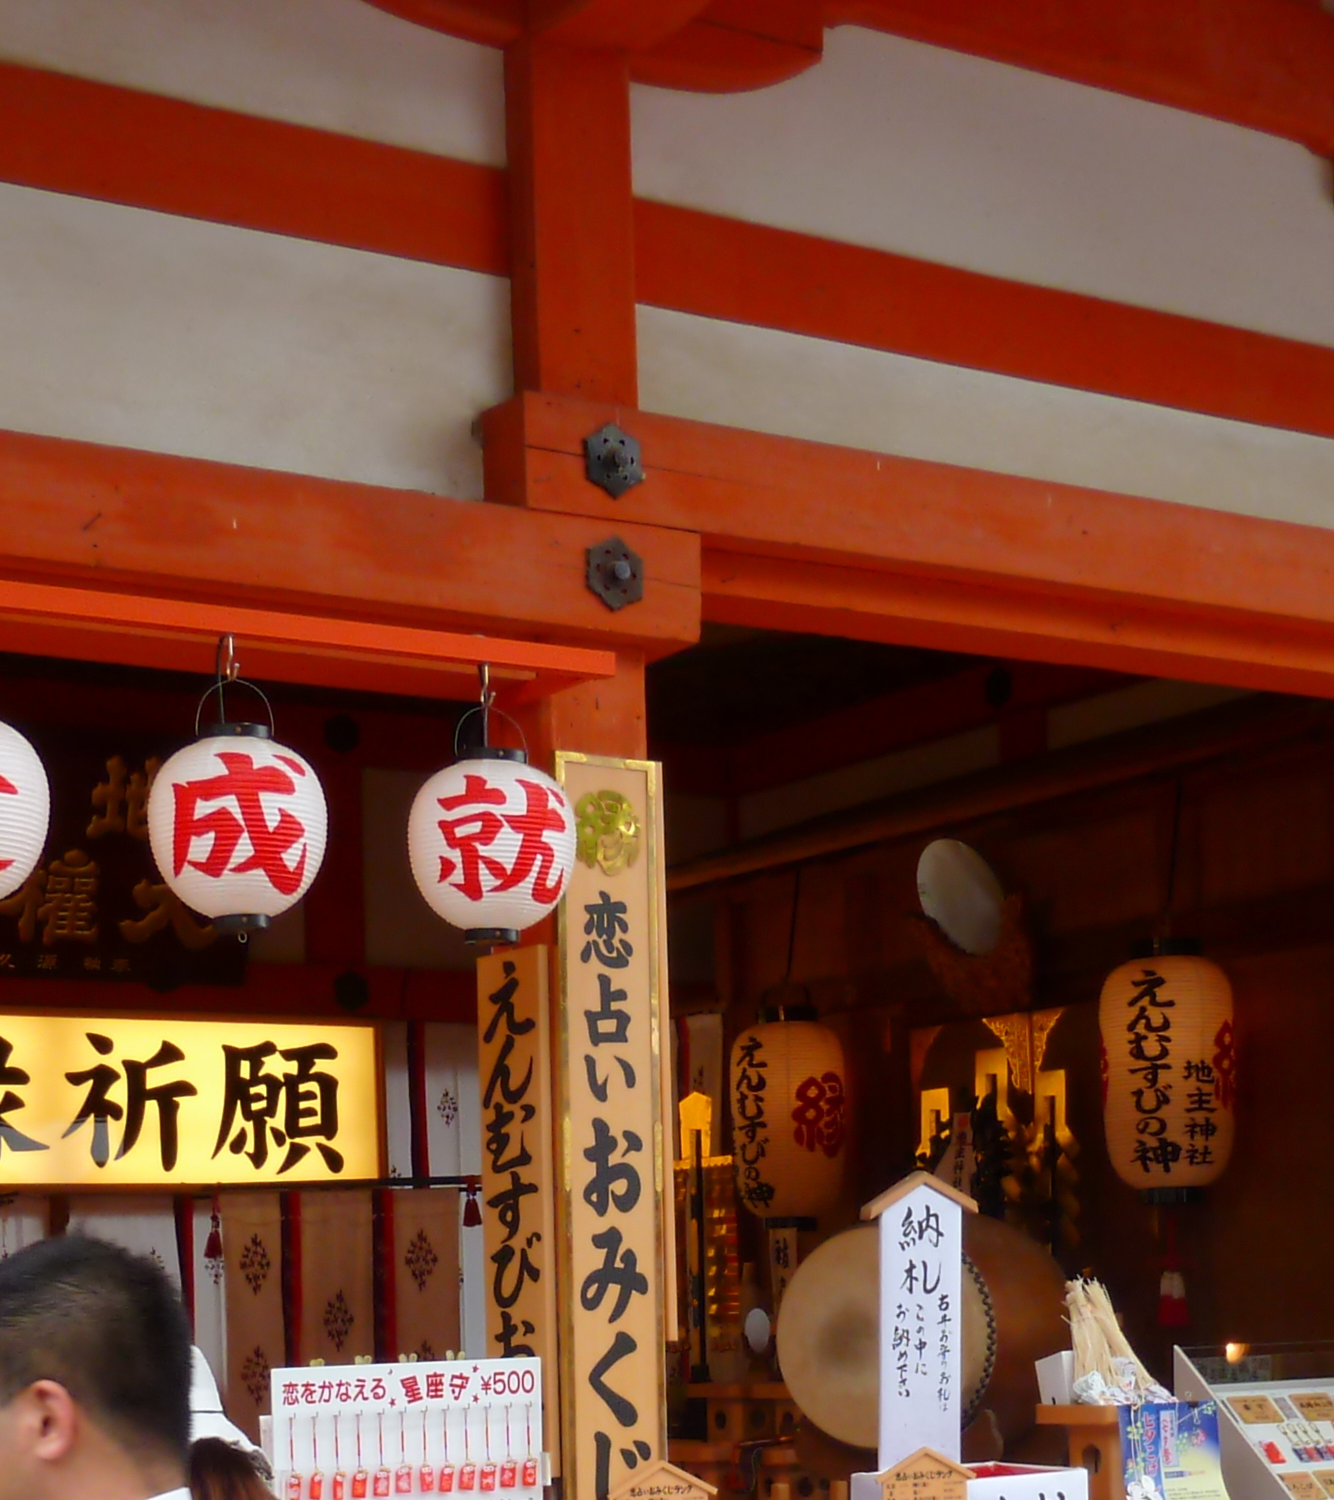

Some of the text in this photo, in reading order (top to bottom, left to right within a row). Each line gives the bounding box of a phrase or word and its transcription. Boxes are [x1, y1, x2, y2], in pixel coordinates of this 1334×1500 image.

[171, 751, 307, 897] 成
[435, 766, 567, 902] 就
[736, 1036, 776, 1208] えんむすびの神
[1127, 969, 1183, 1174] えんむすびの神
[1182, 1059, 1218, 1166] 地主神社
[898, 1204, 945, 1295] 納札
[281, 1369, 535, 1406] 恋をかなえる 星座守 ¥500
